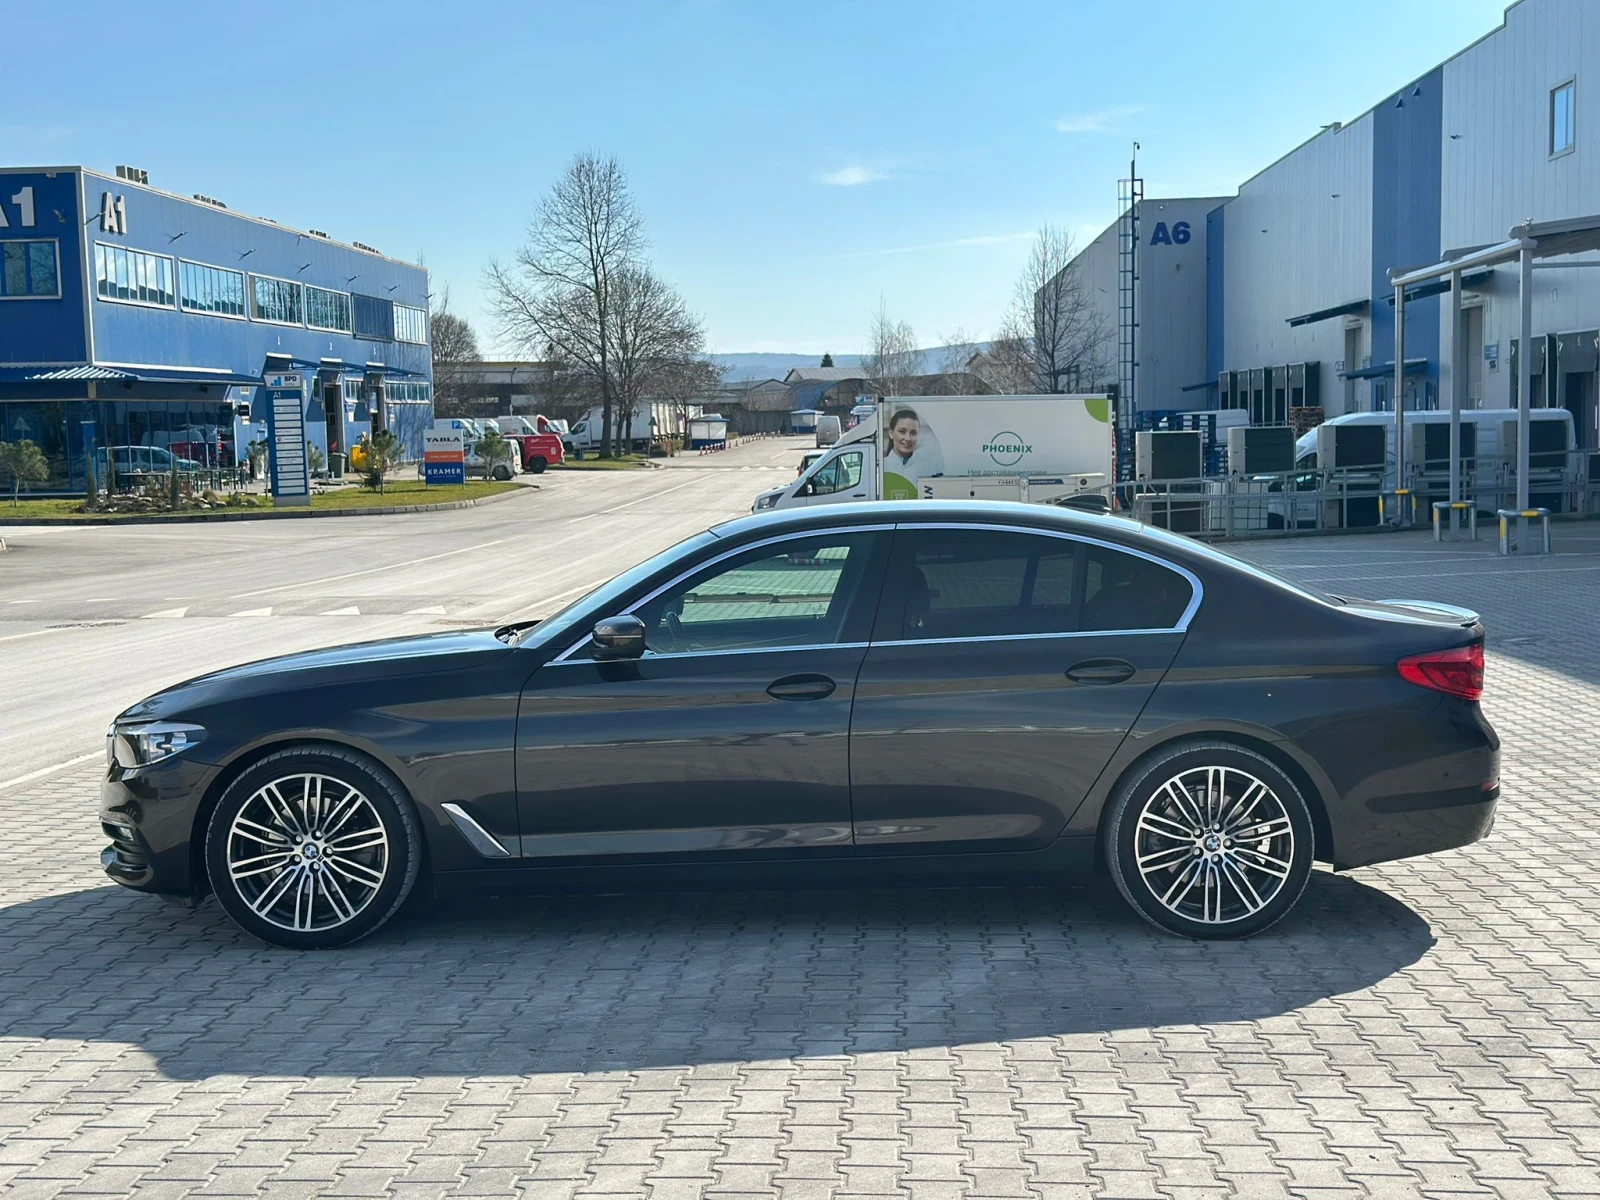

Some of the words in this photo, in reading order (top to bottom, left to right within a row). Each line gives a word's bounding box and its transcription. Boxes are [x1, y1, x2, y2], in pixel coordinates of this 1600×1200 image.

[101, 192, 127, 234] A1
[1150, 221, 1191, 246] A6
[273, 391, 281, 399] A1
[453, 421, 460, 429] P
[982, 445, 1032, 453] PHOENIX
